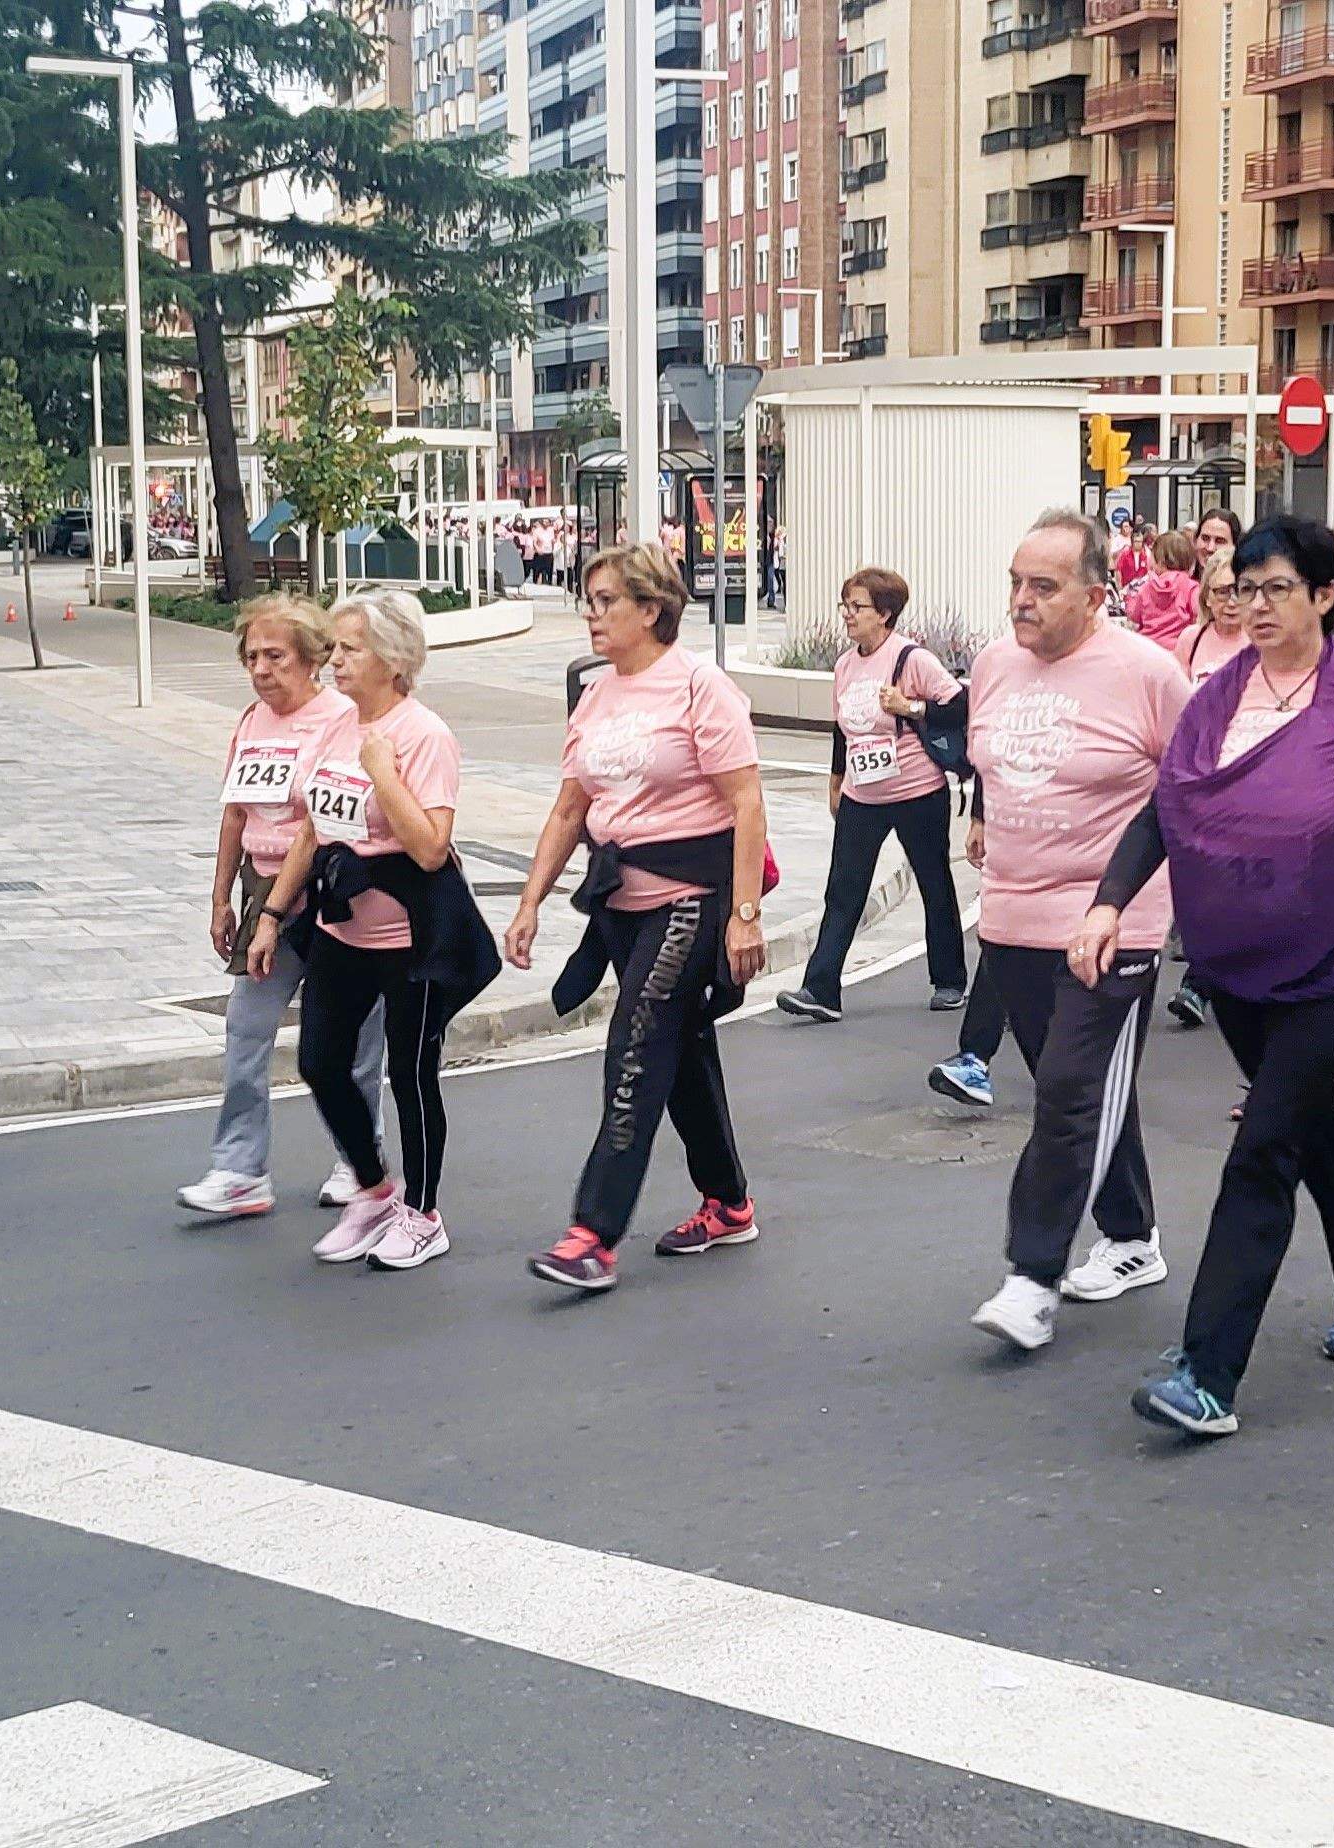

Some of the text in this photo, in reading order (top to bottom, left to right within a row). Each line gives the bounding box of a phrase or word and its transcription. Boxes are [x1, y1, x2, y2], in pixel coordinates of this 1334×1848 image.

[851, 751, 892, 774] 1359
[237, 763, 291, 786] 1243
[308, 787, 359, 821] 1247
